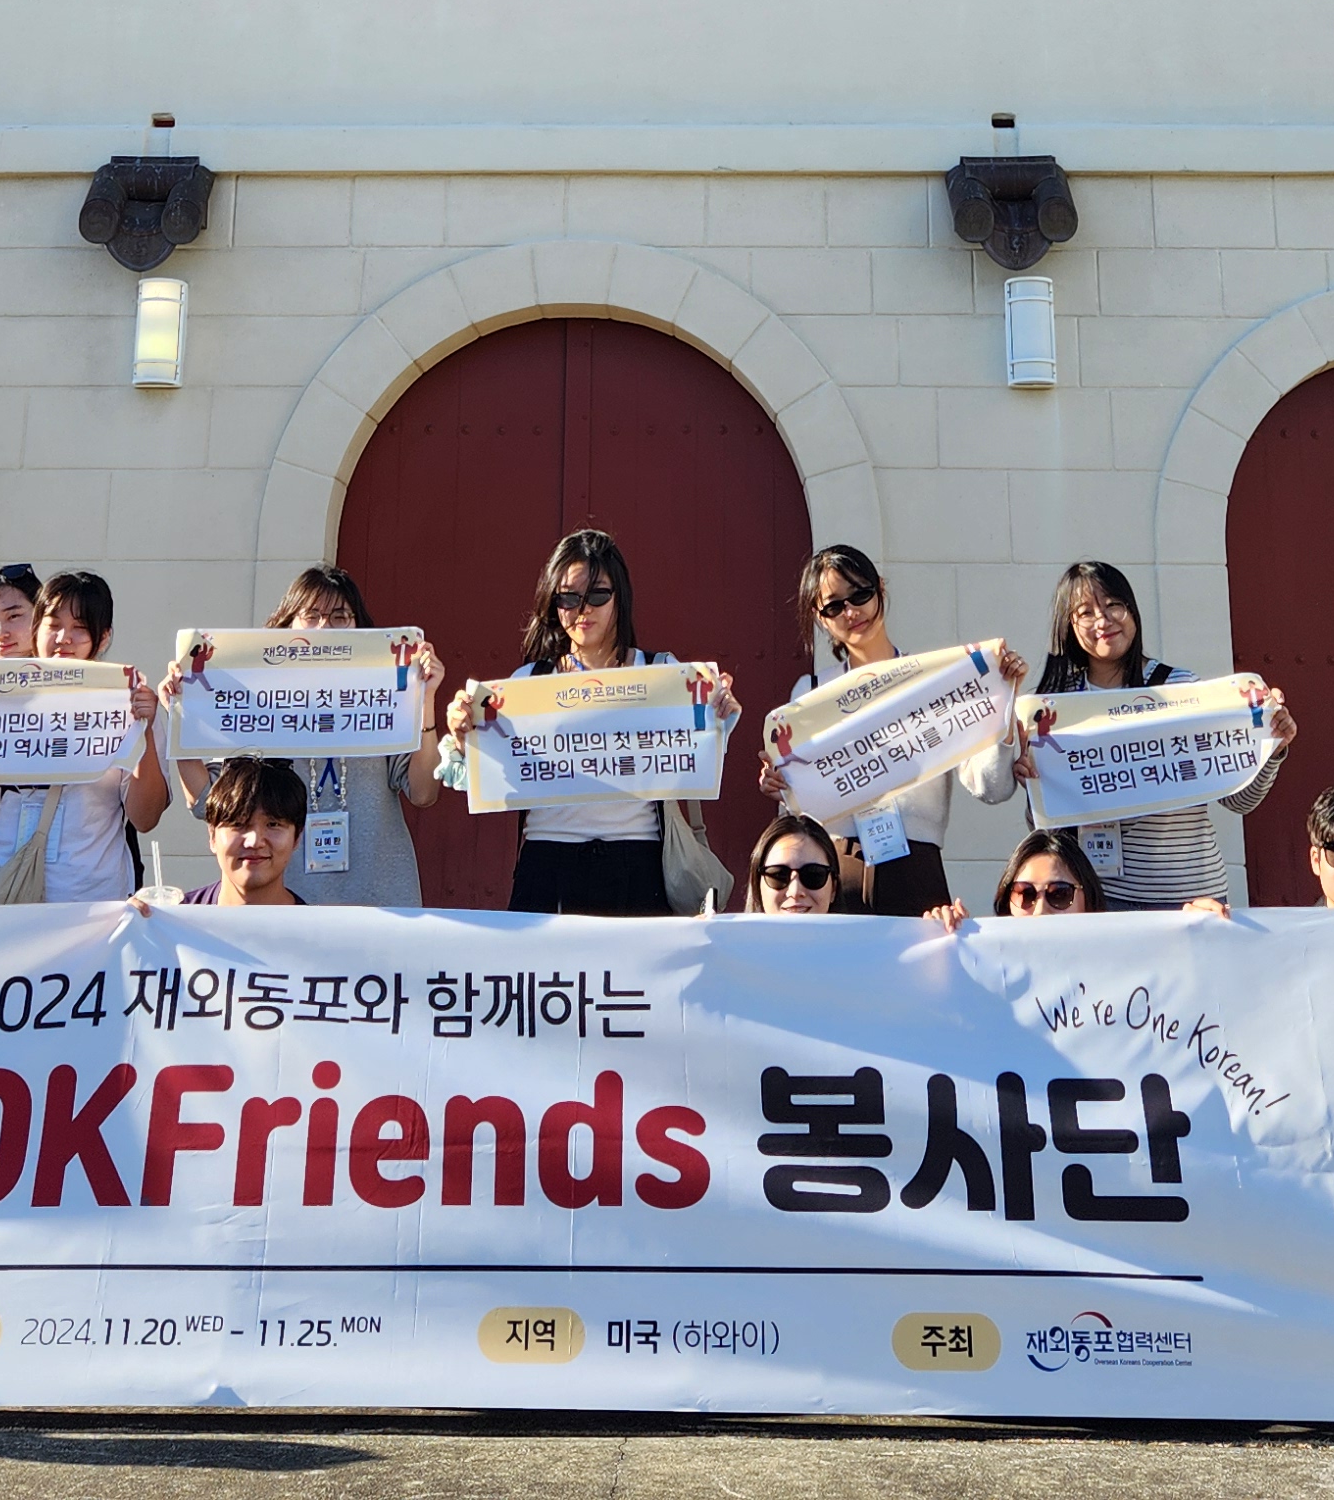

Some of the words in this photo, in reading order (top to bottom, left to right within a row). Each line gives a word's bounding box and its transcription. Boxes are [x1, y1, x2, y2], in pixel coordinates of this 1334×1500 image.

[263, 645, 352, 661] 재외동포협력센터
[214, 689, 250, 709] 한인
[256, 689, 310, 709] 이민의
[315, 688, 333, 708] 첫
[339, 688, 398, 709] 발자취,
[556, 684, 647, 703] 재외동포협력센터
[50, 712, 67, 733] 첫
[220, 714, 275, 733] 희망의
[281, 713, 335, 733] 역사를
[340, 712, 394, 732] 기리며
[813, 747, 854, 778] 한인
[853, 718, 908, 756] 이민의
[908, 707, 929, 729] 첫
[928, 678, 990, 718] 발자취,
[14, 738, 69, 758] 역사를
[510, 736, 547, 757] 한인
[553, 732, 607, 754] 이민의
[613, 730, 631, 751] 첫
[637, 728, 698, 750] 발자취,
[833, 754, 889, 798] 희망의
[888, 728, 943, 764] 역사를
[942, 698, 997, 736] 기리며
[1067, 747, 1106, 771] 한인
[1110, 738, 1165, 763] 이민의
[1170, 735, 1189, 756] 첫
[1193, 727, 1257, 752] 발자취,
[520, 759, 575, 782] 희망의
[581, 756, 636, 777] 역사를
[642, 753, 696, 774] 기리며
[1080, 770, 1138, 796] 희망의
[1141, 761, 1197, 786] 역사를
[1203, 750, 1258, 777] 기리며
[122, 967, 409, 1036] 재외동포와
[426, 969, 651, 1038] 함께하는
[1036, 982, 1117, 1033] We're
[1126, 986, 1179, 1043] One
[1188, 1012, 1292, 1117] Korean!
[757, 1066, 1191, 1222] 봉사단
[21, 1318, 182, 1346] 2024.11.20.
[185, 1315, 224, 1333] WED
[259, 1319, 338, 1347] 11.25.
[340, 1316, 382, 1334] MON
[505, 1318, 556, 1351] 지역
[608, 1319, 662, 1354] 미국
[672, 1319, 780, 1355] (하와이)
[920, 1325, 974, 1358] 주최
[1026, 1326, 1193, 1362] 재외동포협력센터
